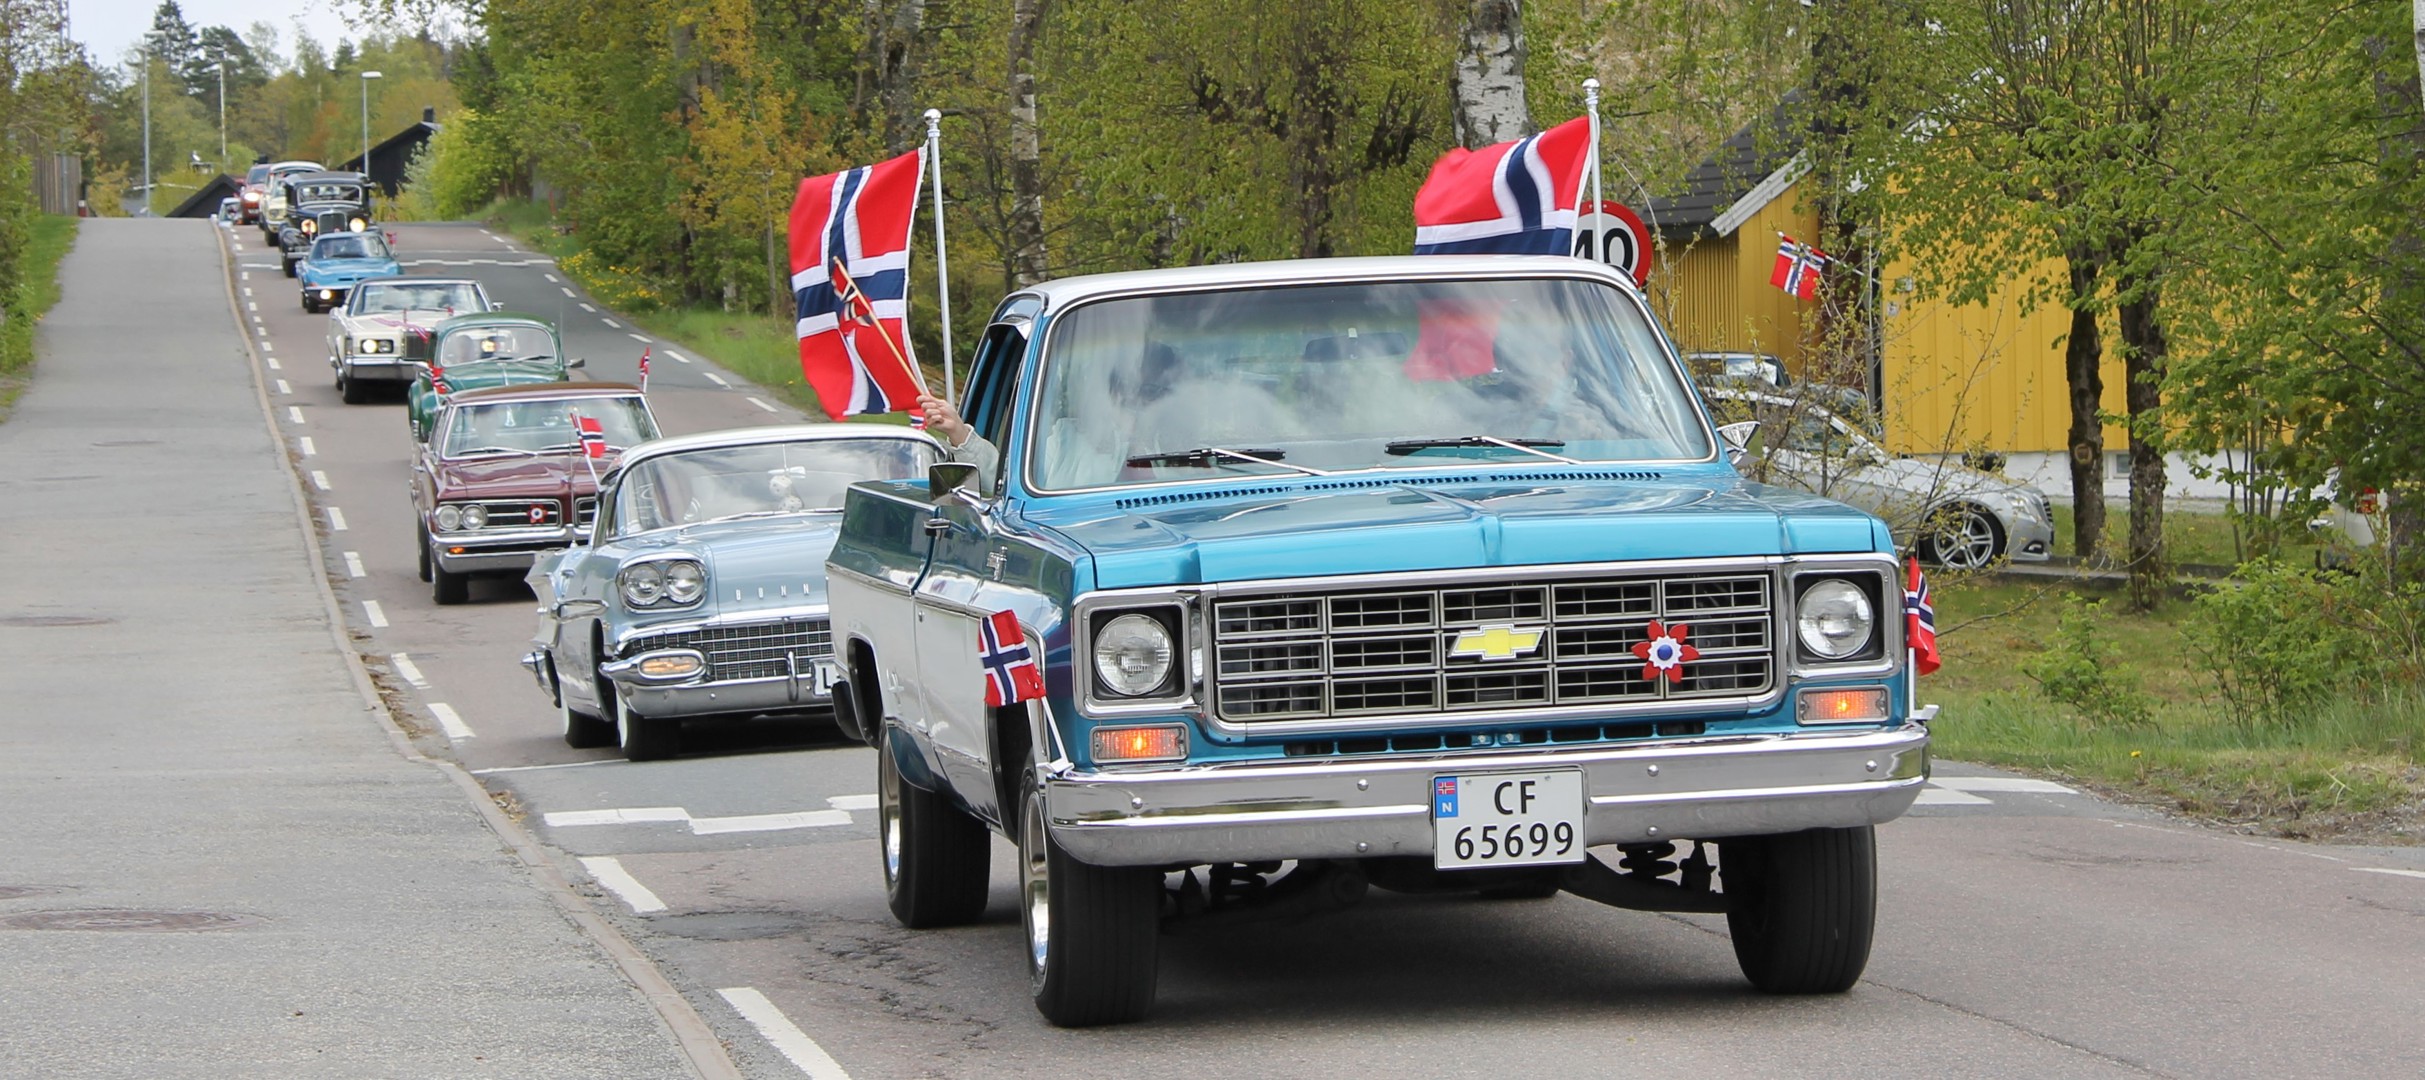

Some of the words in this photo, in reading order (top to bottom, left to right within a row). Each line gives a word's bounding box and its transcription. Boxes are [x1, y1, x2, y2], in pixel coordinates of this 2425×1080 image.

[1574, 228, 1634, 272] 40
[1442, 802, 1453, 813] N
[1494, 780, 1536, 815] CF
[1454, 821, 1574, 860] 65699
